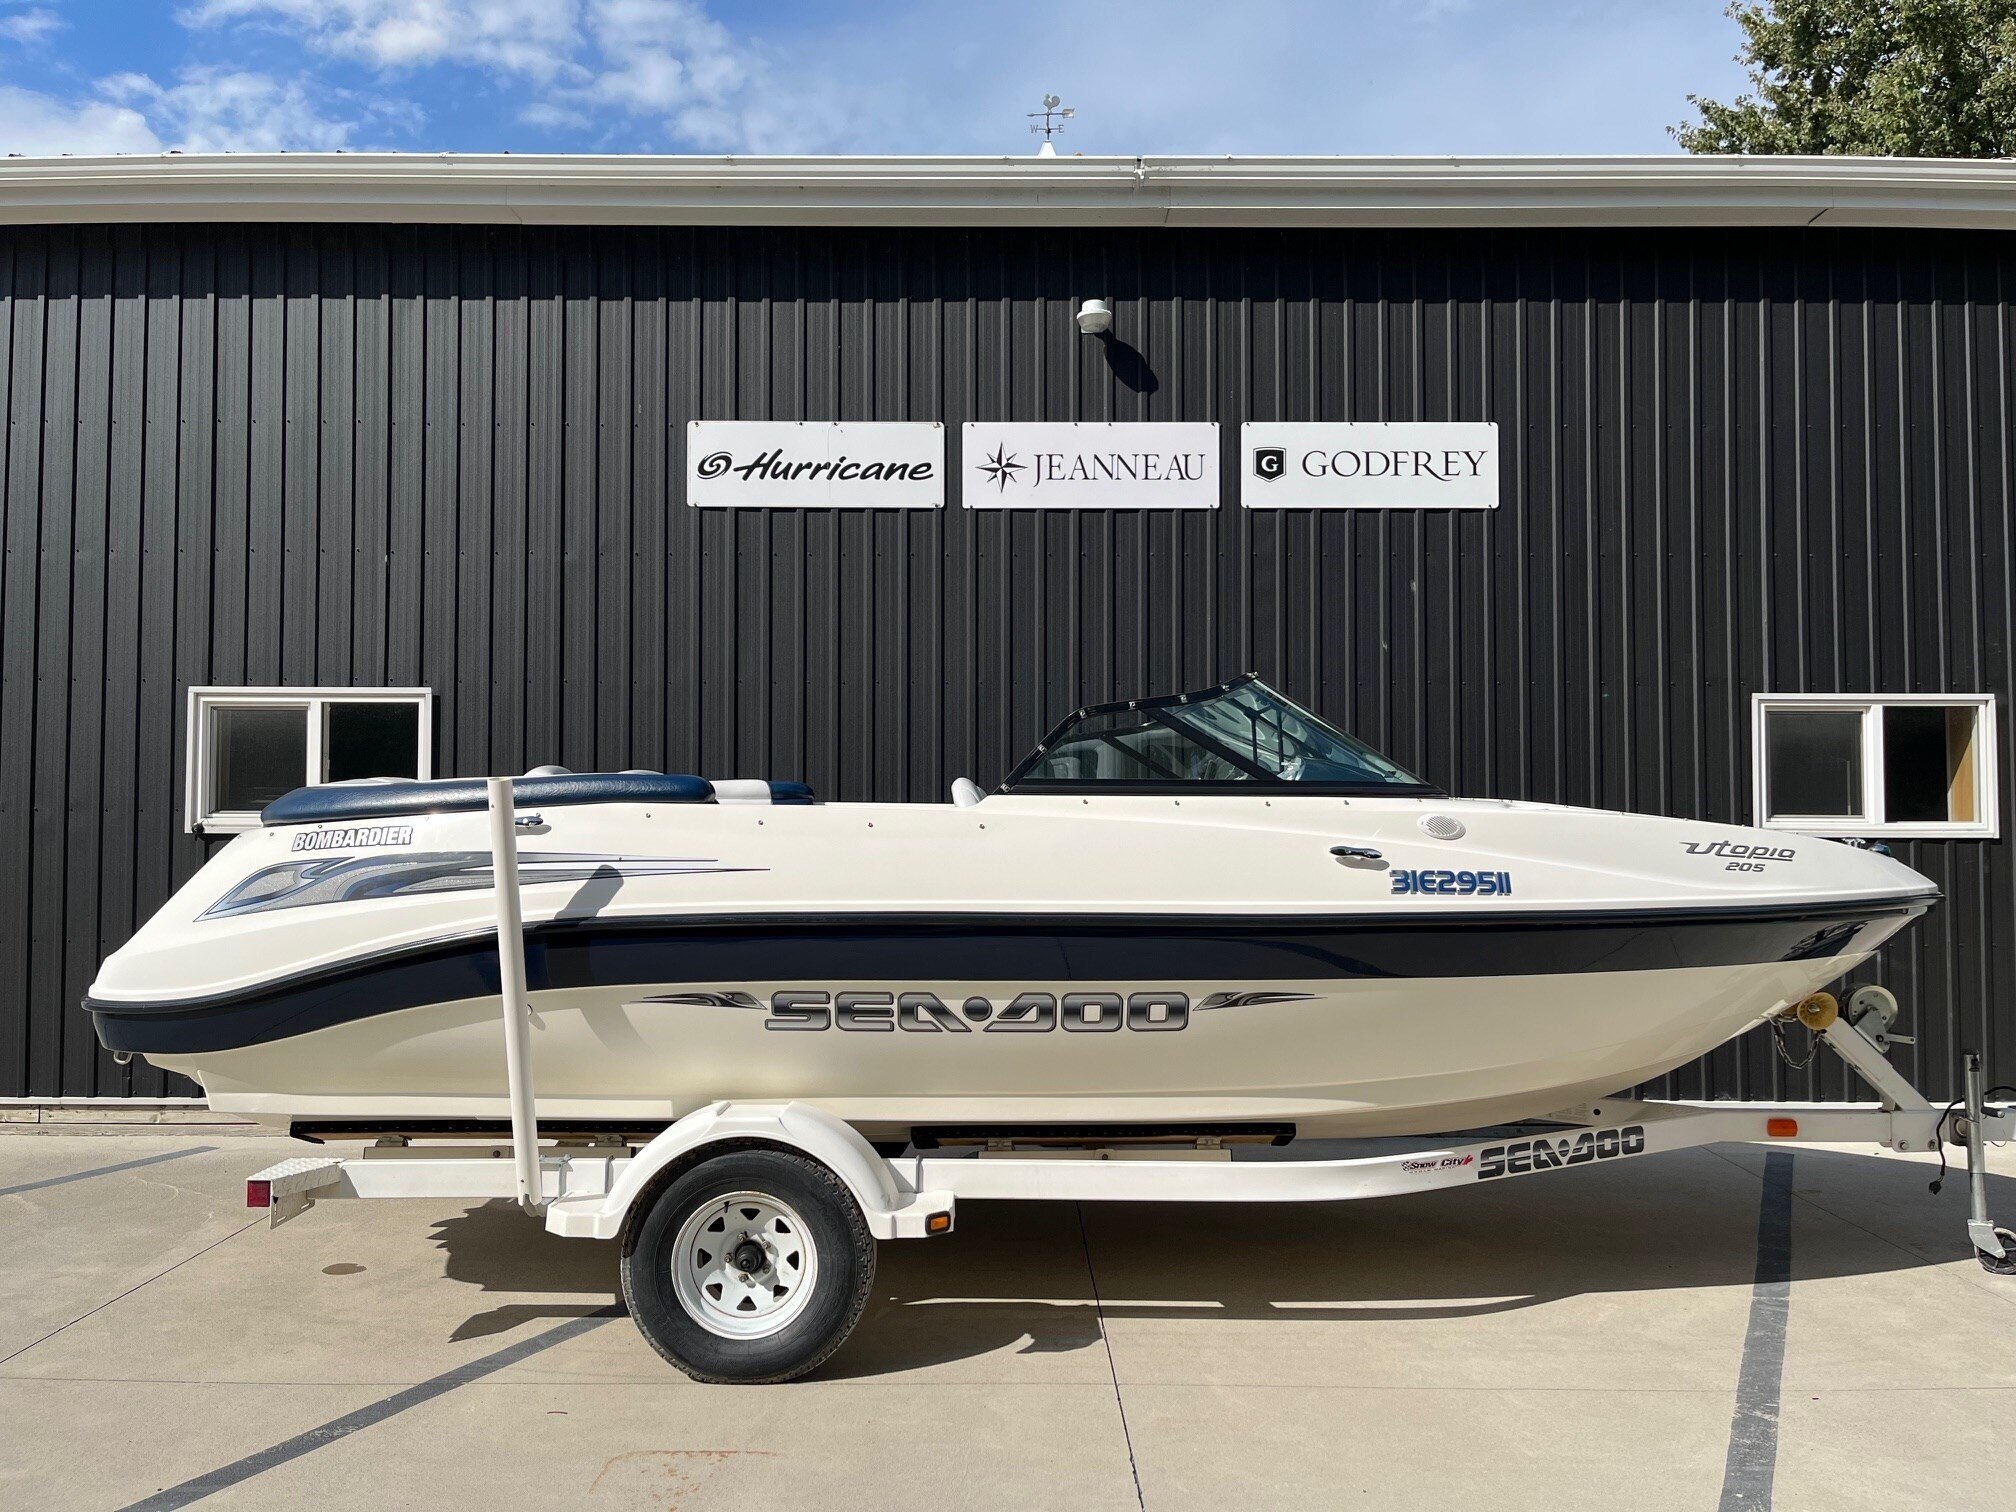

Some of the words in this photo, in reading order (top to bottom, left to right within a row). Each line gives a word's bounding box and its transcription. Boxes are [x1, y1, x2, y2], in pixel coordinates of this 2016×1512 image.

[733, 449, 934, 481] Hurricane
[1032, 453, 1206, 488] JEANNEAU
[1261, 455, 1279, 472] G
[1302, 450, 1488, 482] GODFREY
[291, 825, 413, 852] BOMBARDIER
[1725, 861, 1766, 872] 205
[1409, 1161, 1437, 1170] Snow
[1441, 1157, 1465, 1167] City
